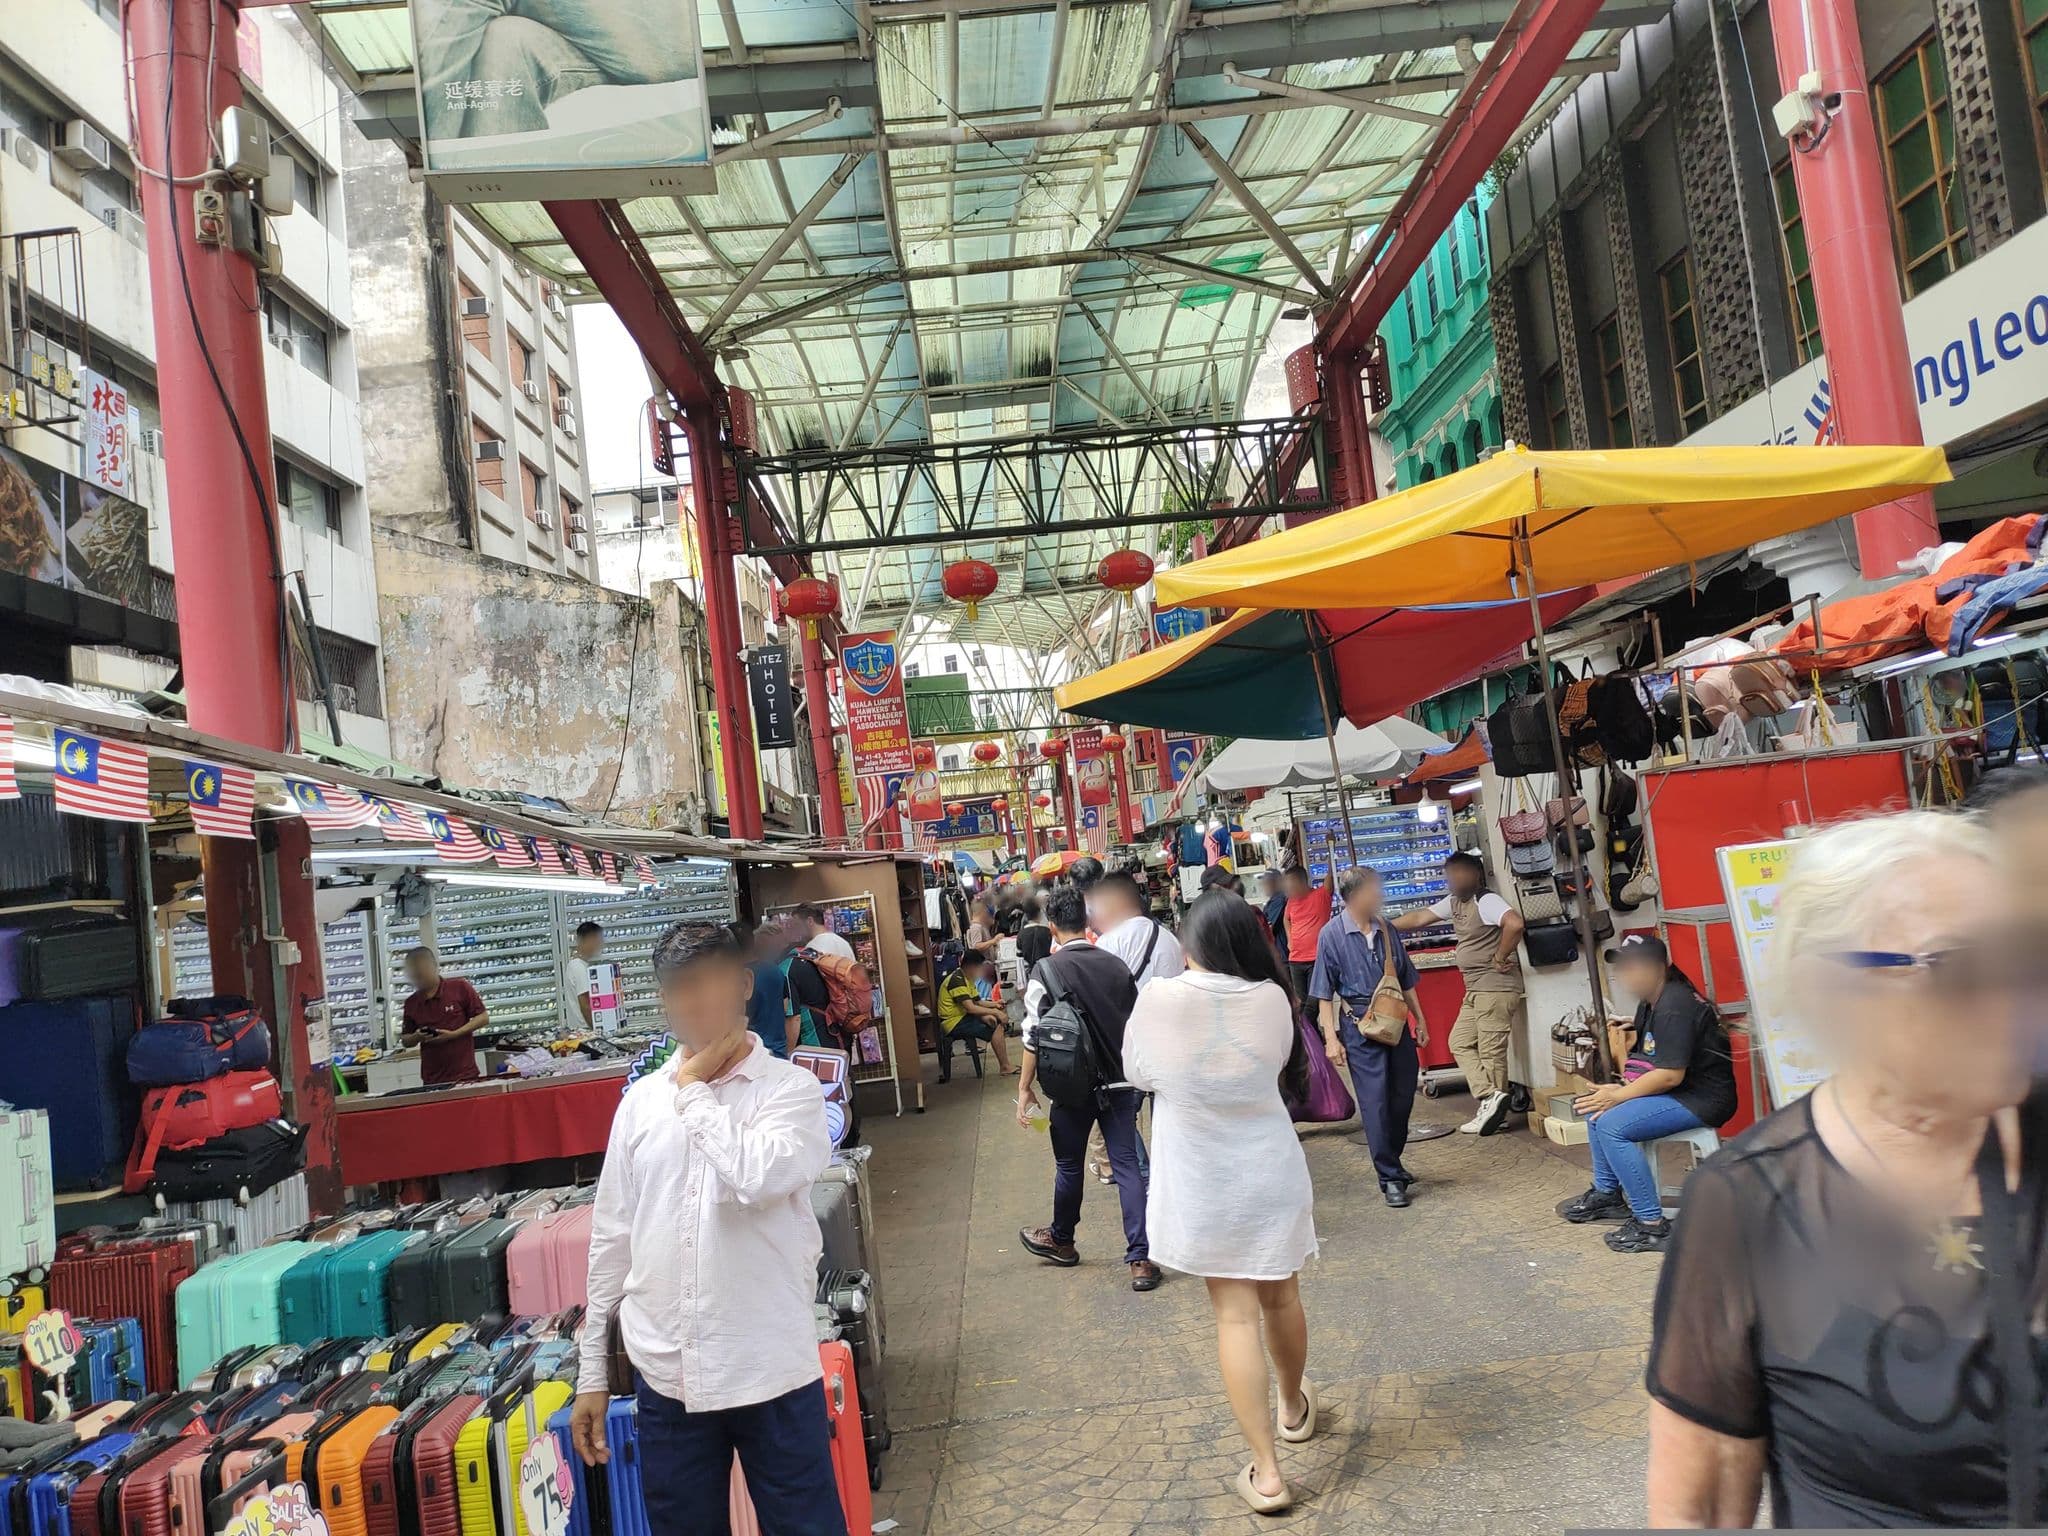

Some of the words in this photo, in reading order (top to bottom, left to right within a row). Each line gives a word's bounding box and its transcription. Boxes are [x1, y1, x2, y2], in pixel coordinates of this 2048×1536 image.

[444, 79, 524, 101] 延缓衰老
[446, 100, 499, 112] Anti-Aging
[756, 653, 783, 665] ITEZ
[763, 668, 779, 739] HOTEL
[850, 700, 873, 710] KUALA
[874, 696, 901, 706] LUMPUR
[850, 714, 872, 724] PETTY
[856, 718, 901, 731] ASSOCIATION
[963, 804, 991, 817] ING
[941, 826, 974, 837] STREET
[28, 1319, 48, 1336] Only
[34, 1327, 74, 1366] 110
[522, 1456, 543, 1483] Only
[533, 1472, 563, 1531] 75
[270, 1502, 304, 1523] SALE!
